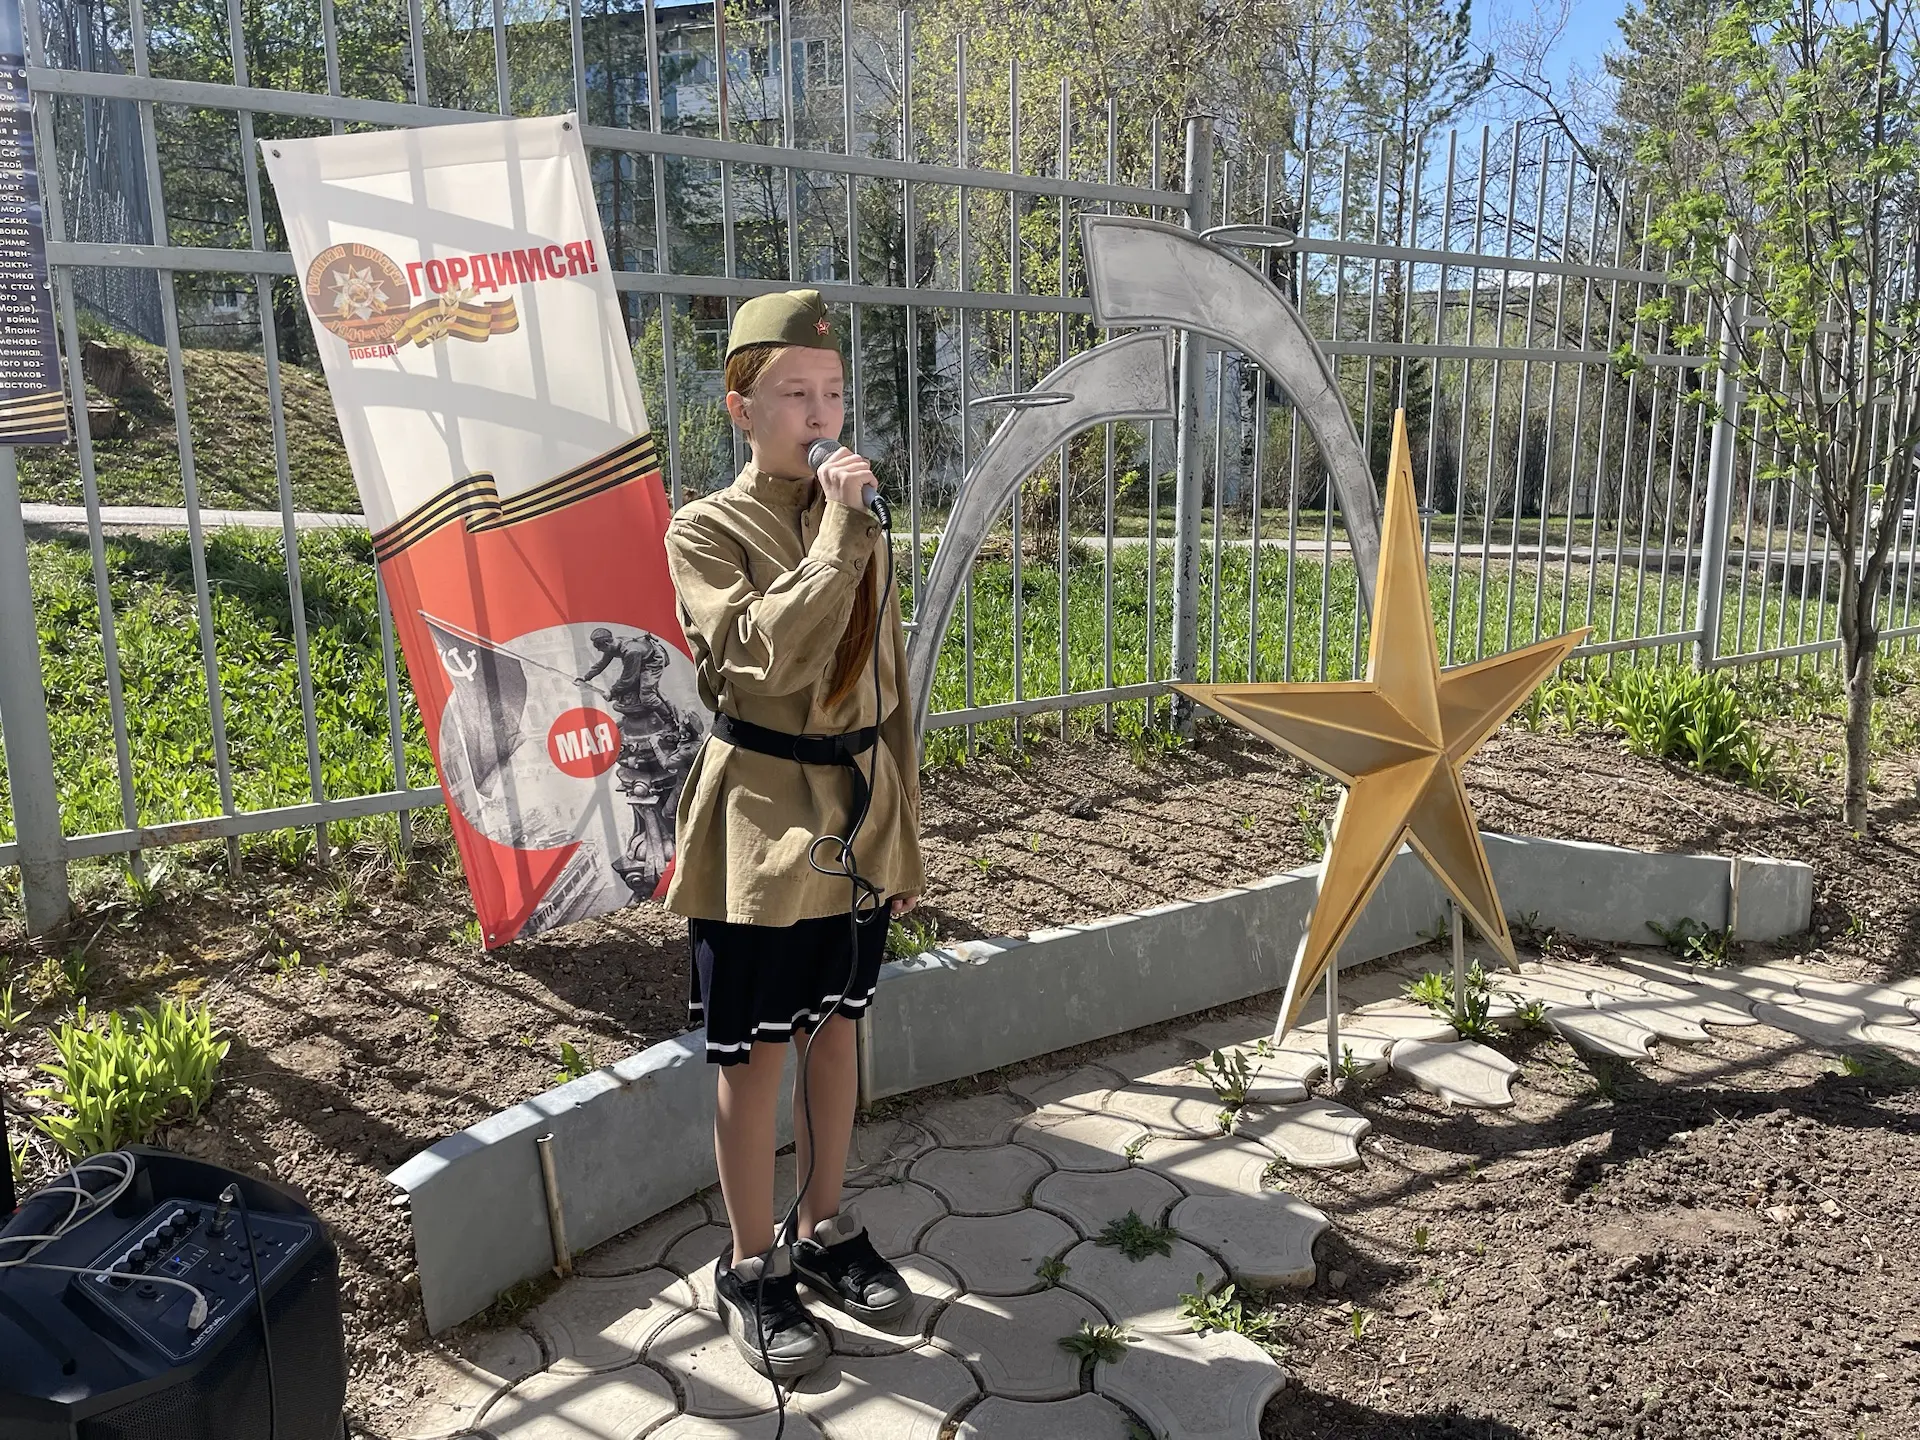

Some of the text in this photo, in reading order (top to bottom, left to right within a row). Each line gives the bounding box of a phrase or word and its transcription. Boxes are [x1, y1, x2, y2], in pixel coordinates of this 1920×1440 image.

[2, 149, 20, 158] Со-
[1, 206, 27, 215] мор-
[405, 239, 599, 297] ГОРДИМСЯ!
[7, 315, 39, 324] войны
[349, 343, 399, 360] ПОБЕДА!
[554, 722, 615, 764] МАЯ
